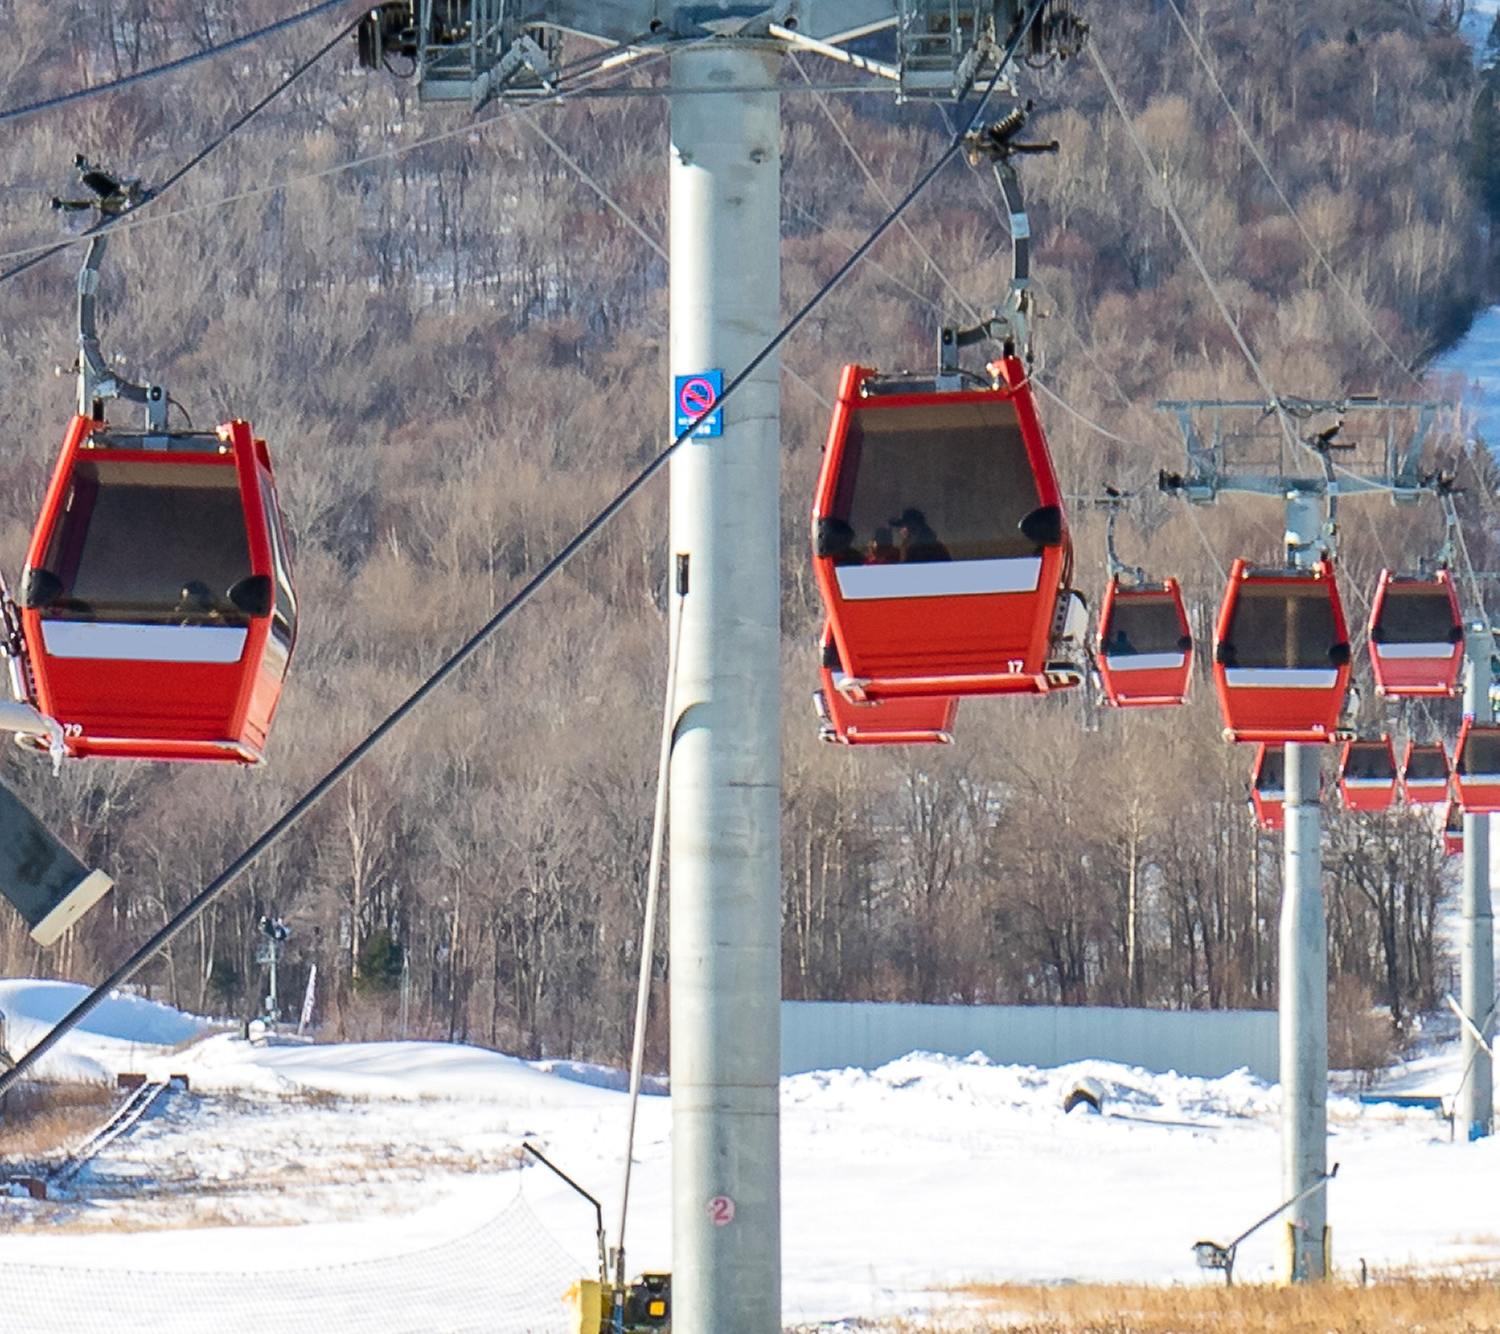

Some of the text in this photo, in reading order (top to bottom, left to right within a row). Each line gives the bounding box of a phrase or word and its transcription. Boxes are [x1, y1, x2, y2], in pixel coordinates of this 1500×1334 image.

[1007, 659, 1024, 675] 17
[63, 723, 83, 738] 79
[714, 1196, 730, 1221] 2
